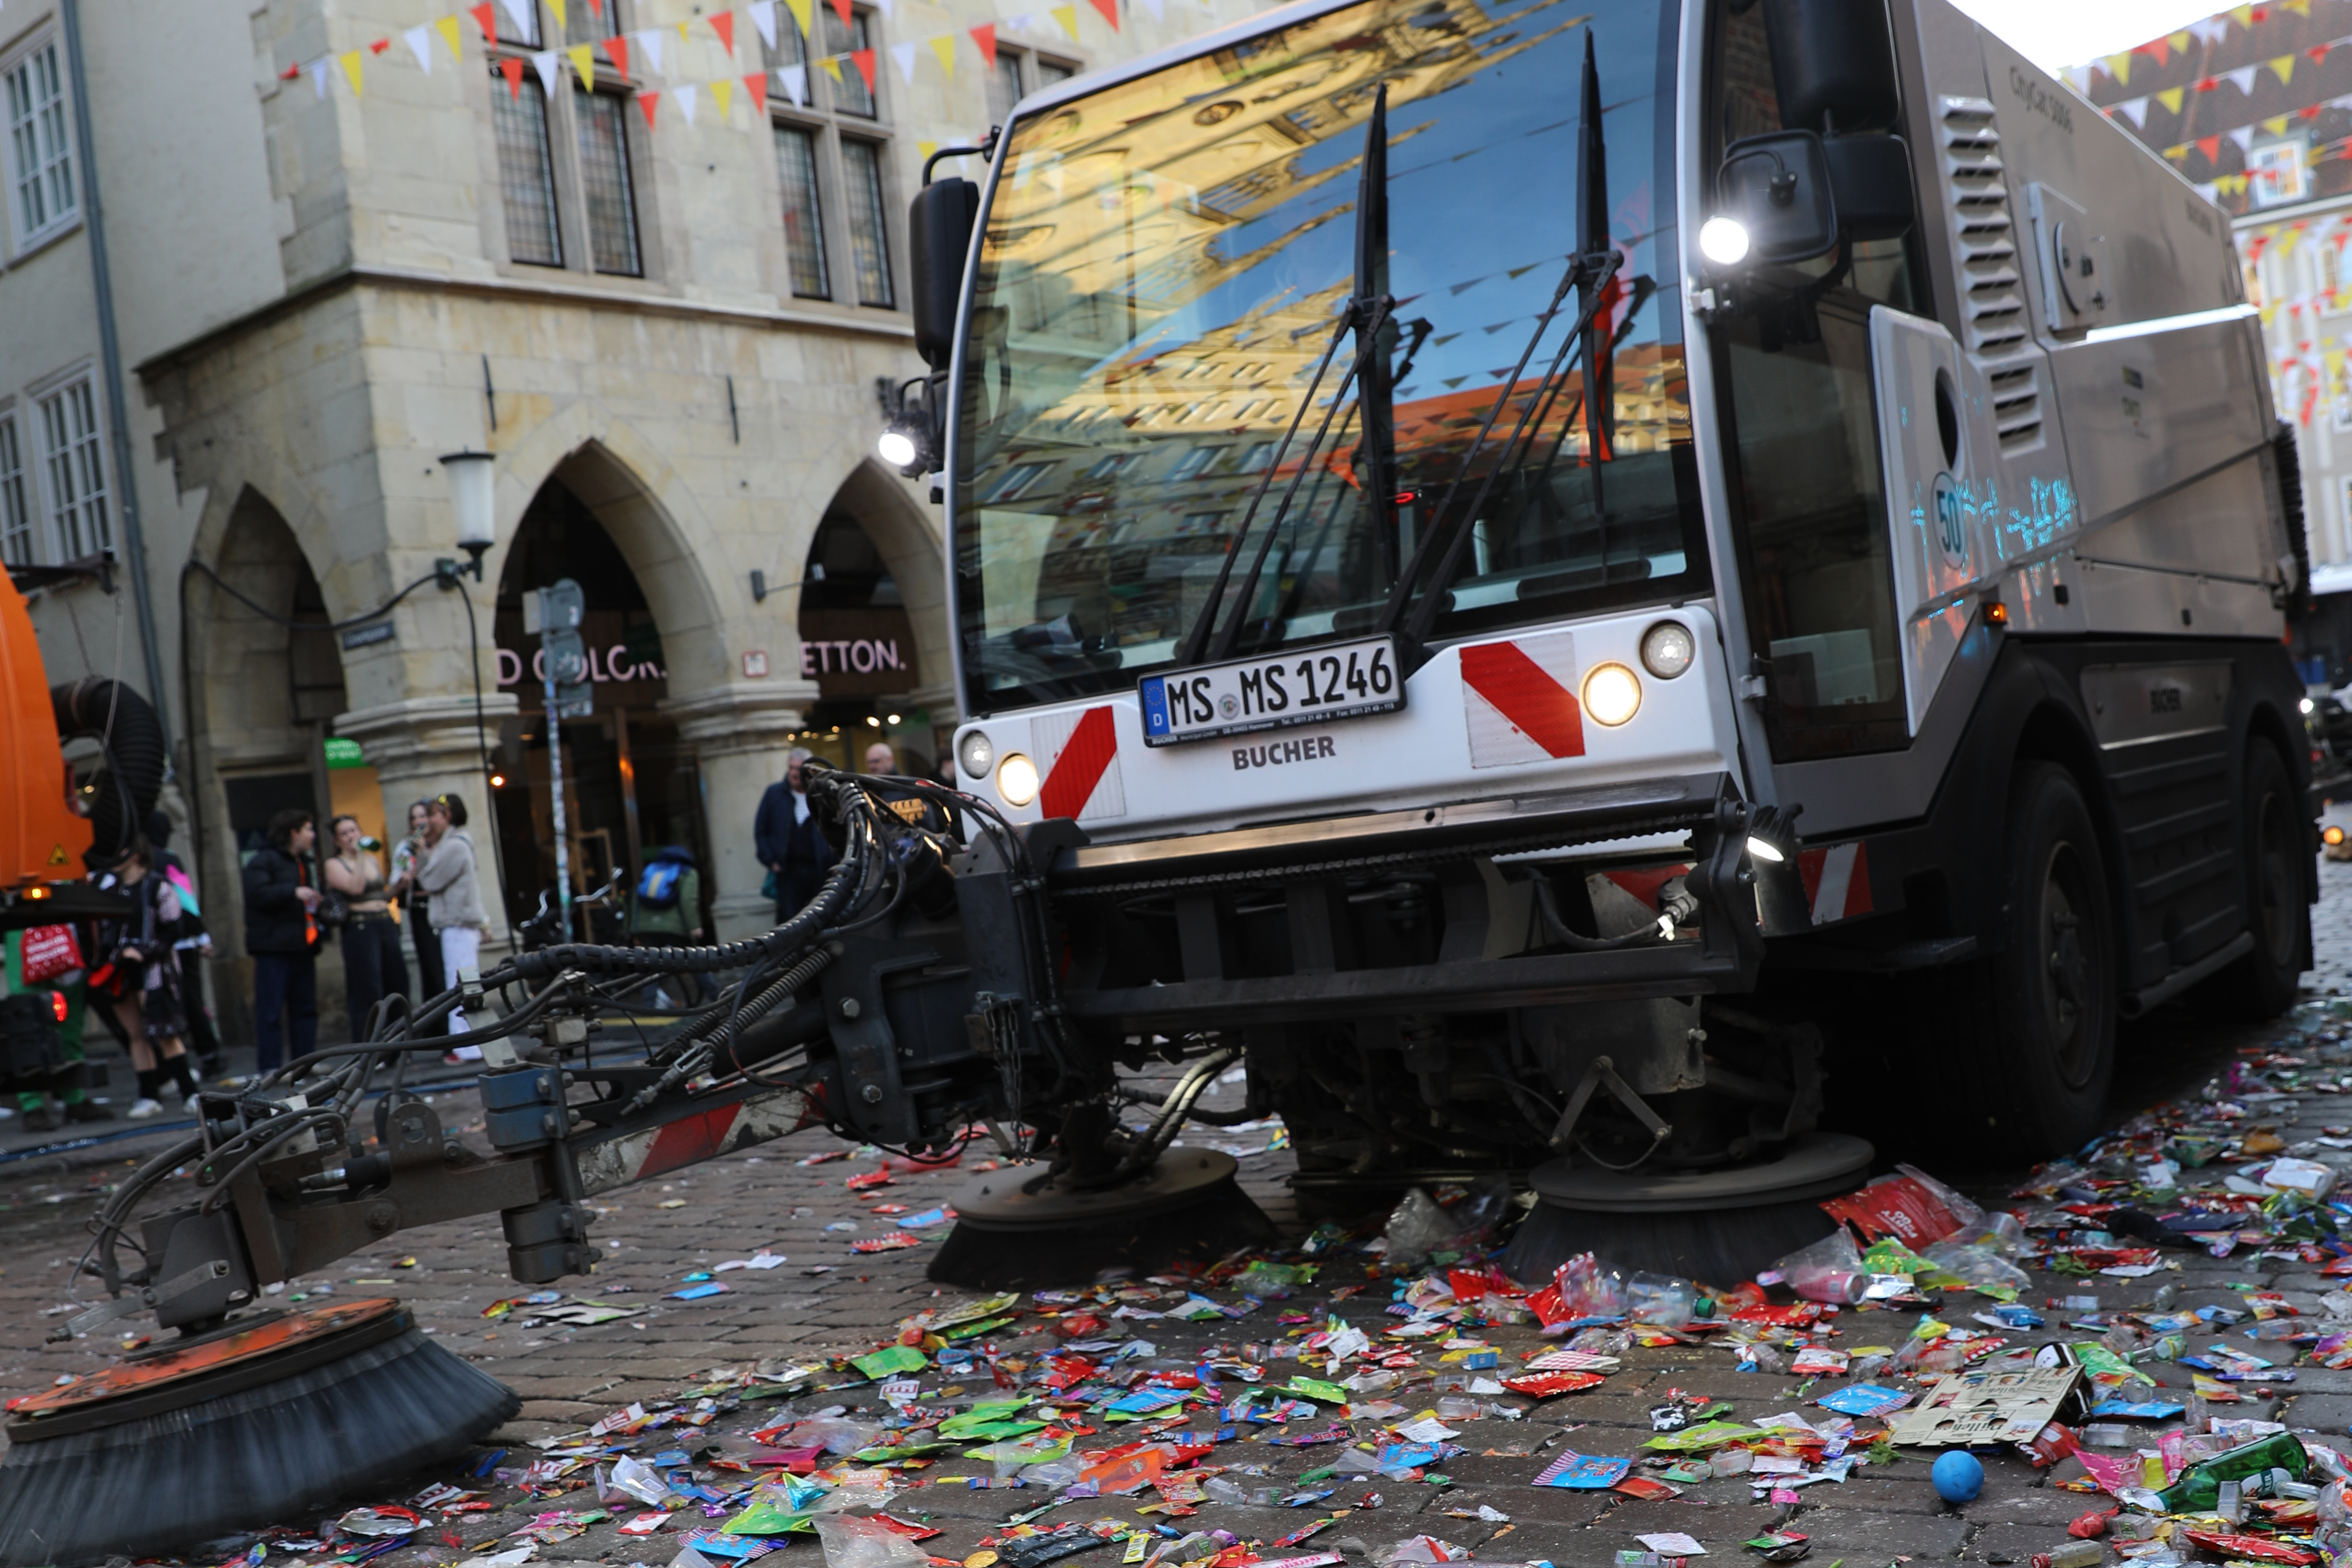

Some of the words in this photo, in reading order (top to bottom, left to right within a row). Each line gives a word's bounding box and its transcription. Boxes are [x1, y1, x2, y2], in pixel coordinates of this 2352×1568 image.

[1936, 489, 1961, 554] 50
[801, 639, 907, 675] ETTON.
[1167, 677, 1214, 726] MS
[1239, 665, 1289, 715] MS
[1297, 646, 1392, 707] 1246
[1152, 735, 1178, 745] BUCHER
[1249, 721, 1275, 729] Hannover
[1153, 713, 1163, 727] D
[1232, 735, 1336, 770] BUCHER
[1881, 1210, 1918, 1238] PARTY
